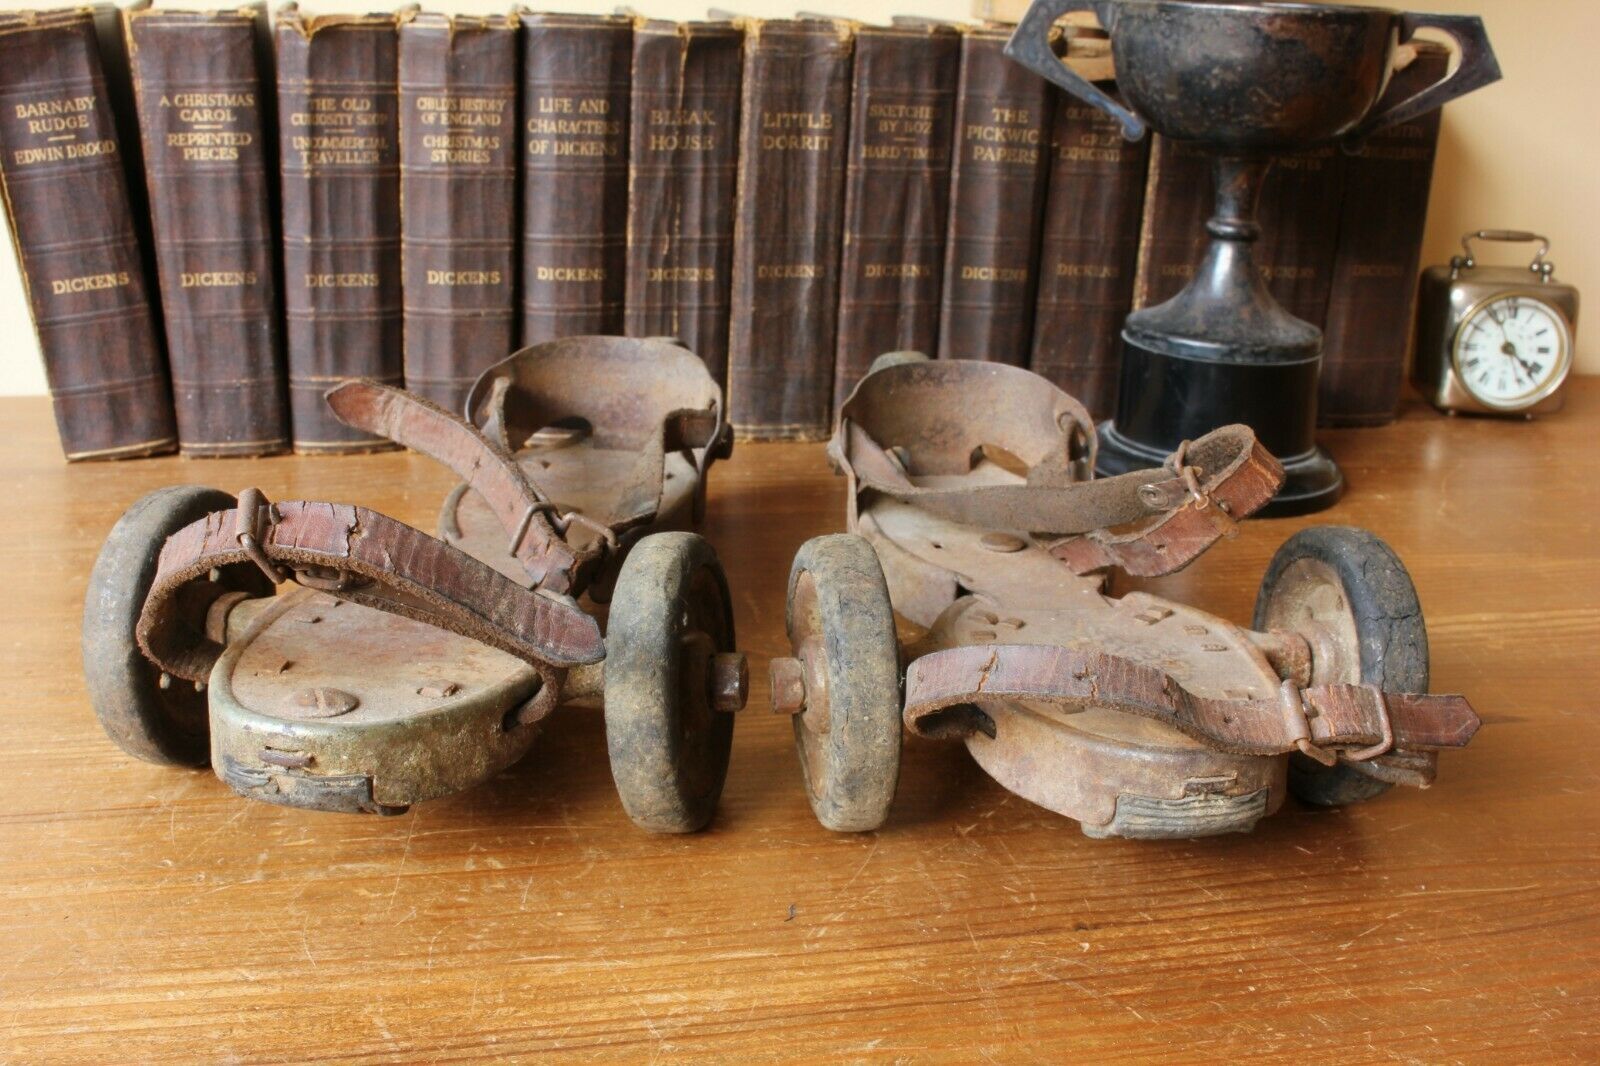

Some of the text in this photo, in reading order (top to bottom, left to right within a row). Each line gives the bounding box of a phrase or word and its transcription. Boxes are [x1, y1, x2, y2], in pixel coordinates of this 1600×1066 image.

[16, 96, 96, 119] BARNABY
[159, 94, 255, 108] A CHRISTMAS
[341, 97, 371, 111] OLD
[460, 97, 507, 112] HISTORY
[539, 98, 610, 115] LIFE AND
[180, 109, 237, 122] CAROL
[421, 112, 501, 126] OF ENGLAND
[763, 112, 834, 129] LITTLE
[992, 108, 1029, 124] THE
[29, 114, 89, 134] RUDGE
[527, 118, 620, 135] CHARACTERS
[878, 121, 898, 134] BY
[167, 132, 252, 146] REPRINTED
[423, 135, 500, 149] CHRISTMAS
[967, 125, 1040, 144] PICKWIC
[529, 140, 617, 156] OF DICKENS
[762, 135, 833, 150] DORRIT
[15, 140, 116, 165] EDWIN DROOD
[183, 147, 239, 160] PIECES
[431, 149, 490, 163] STORIES
[861, 145, 900, 160] HARD
[973, 146, 1039, 164] PAPERS
[427, 270, 501, 286] DICKENS
[537, 267, 606, 281] DICKENS
[648, 267, 715, 281] DICKENS
[758, 265, 824, 279] DICKENS
[961, 266, 1028, 282] DICKENS
[52, 272, 129, 295] DICKENS
[181, 272, 257, 288] DICKENS
[305, 273, 379, 288] DICKENS
